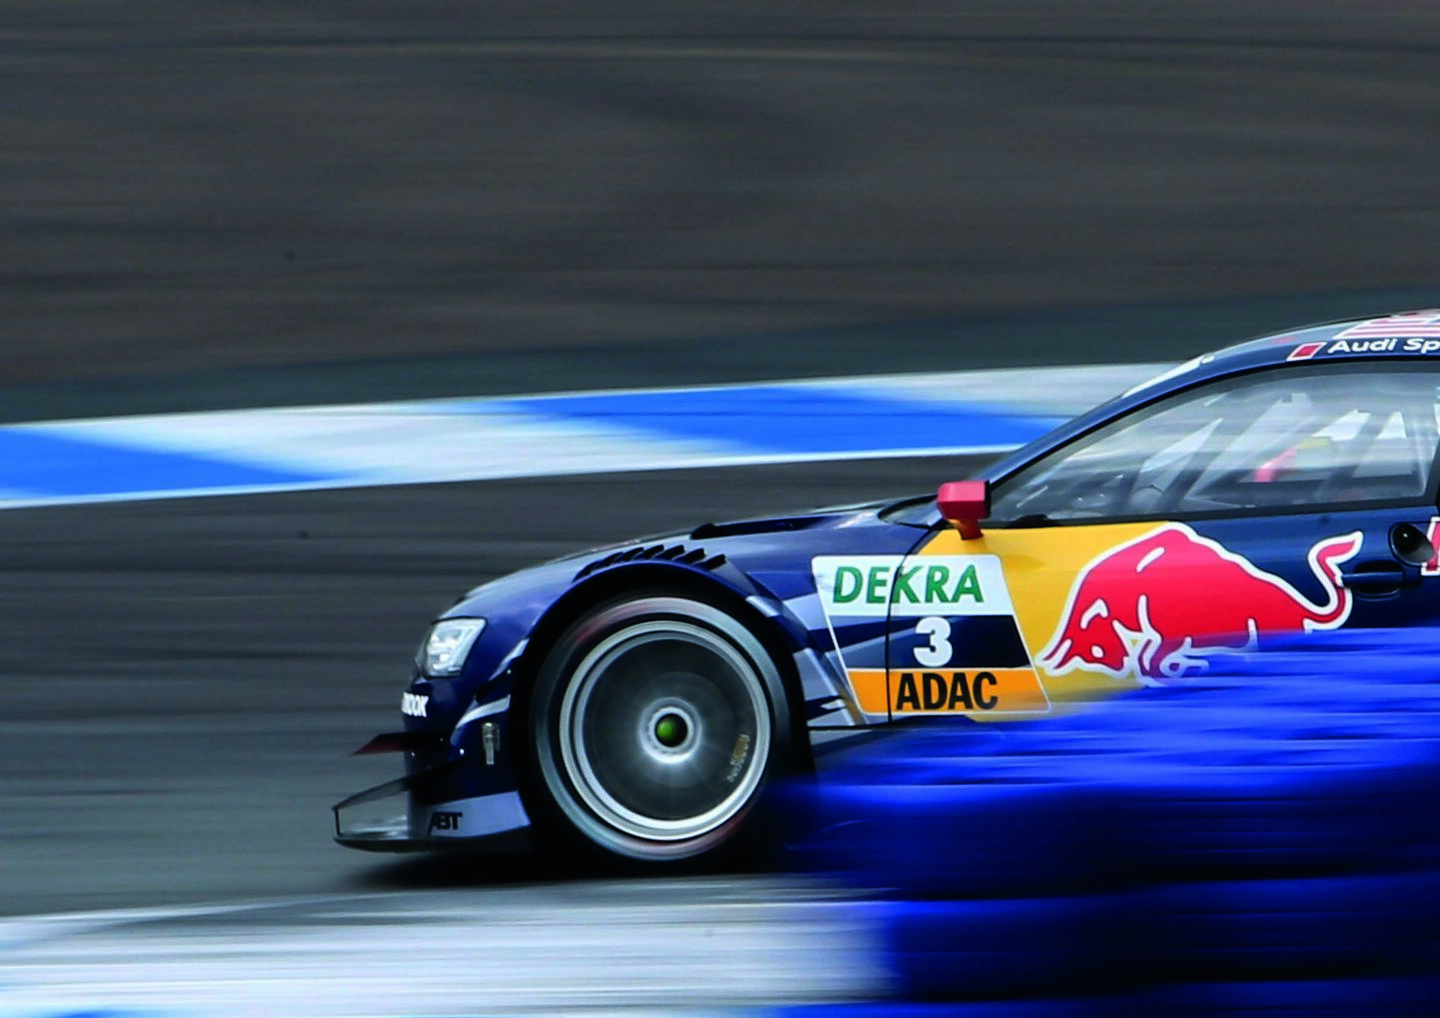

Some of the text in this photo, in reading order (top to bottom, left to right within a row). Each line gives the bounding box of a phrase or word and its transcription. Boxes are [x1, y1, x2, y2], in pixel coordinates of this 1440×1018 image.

[1327, 338, 1397, 354] Audi
[833, 564, 984, 604] DEKRA
[913, 616, 953, 667] 3
[896, 671, 998, 711] ADAC
